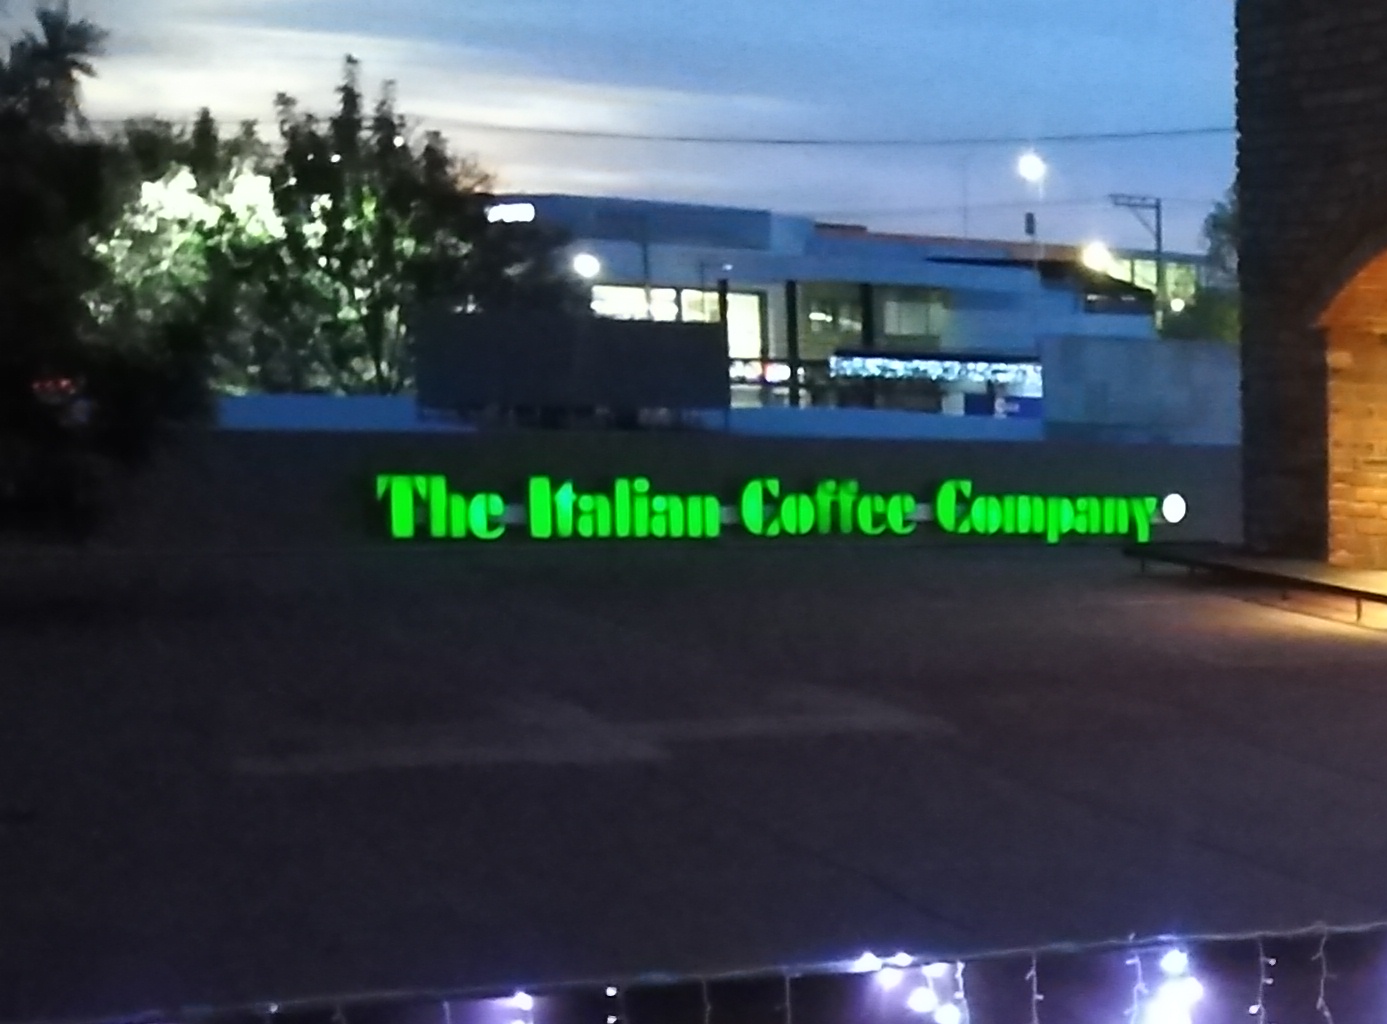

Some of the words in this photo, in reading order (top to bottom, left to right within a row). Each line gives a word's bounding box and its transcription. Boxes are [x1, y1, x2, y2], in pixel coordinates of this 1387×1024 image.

[376, 474, 505, 539] The
[528, 476, 721, 539] Italian
[741, 477, 917, 537] Coffee
[936, 479, 1158, 543] Company
